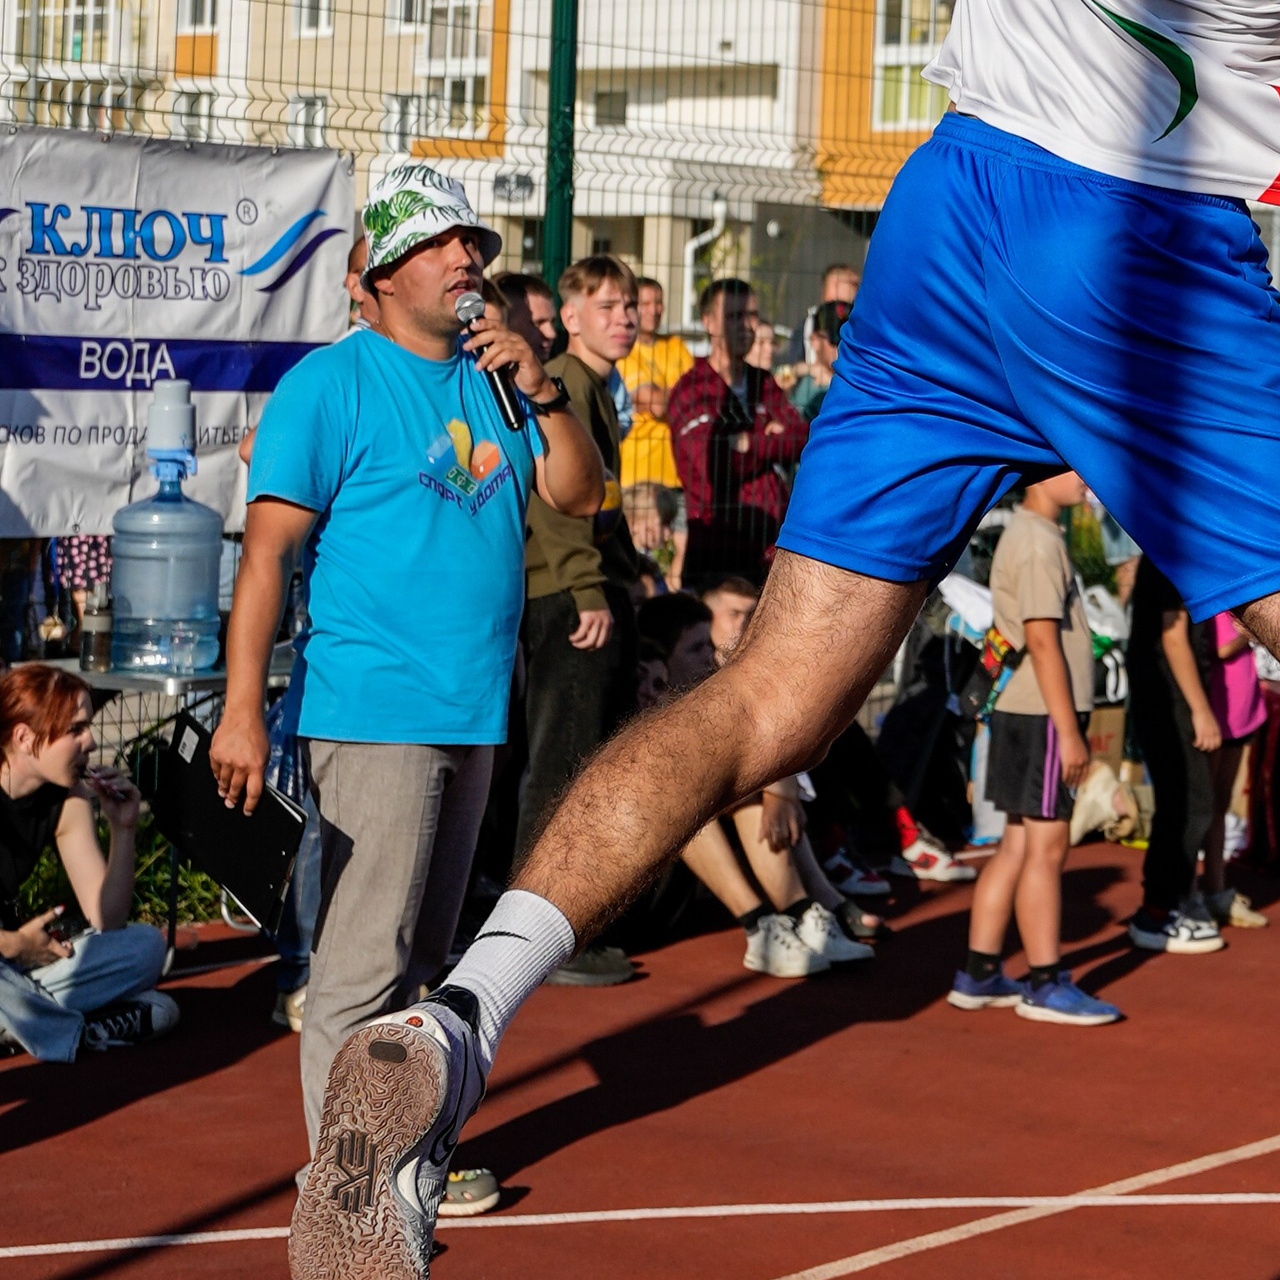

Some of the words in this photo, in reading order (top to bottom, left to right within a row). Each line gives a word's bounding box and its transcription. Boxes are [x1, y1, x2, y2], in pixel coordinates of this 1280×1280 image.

[25, 202, 229, 263] КЛЮЧ
[16, 257, 231, 310] здоровью
[80, 341, 176, 388] ВОДА
[53, 425, 82, 445] ПО
[88, 425, 148, 449] ПРОД
[199, 425, 247, 445] ИТЬЕ
